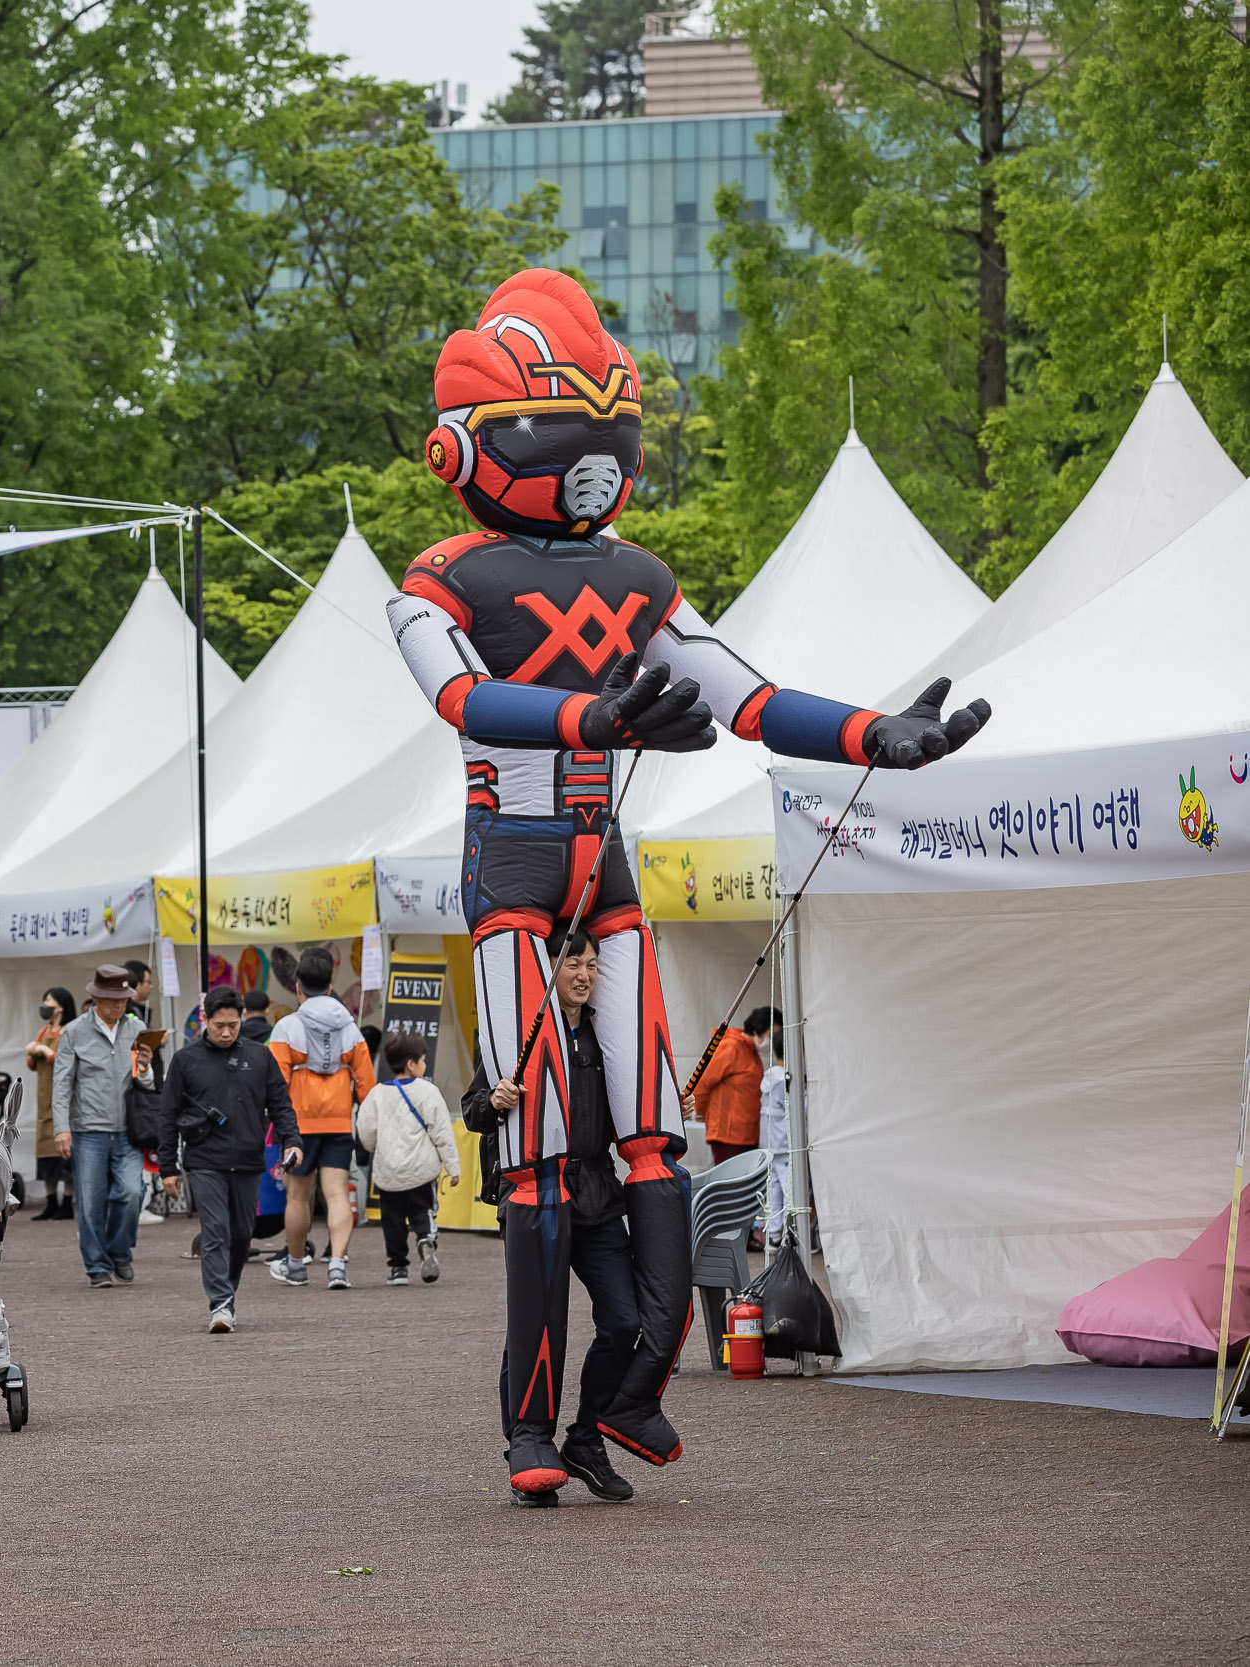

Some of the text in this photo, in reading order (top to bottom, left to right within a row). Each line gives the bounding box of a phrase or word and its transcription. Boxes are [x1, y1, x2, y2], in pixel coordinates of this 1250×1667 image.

[793, 794, 822, 811] 광진구
[900, 787, 1141, 860] 해피할머니 옛이야기 여행
[712, 871, 756, 902] 업싸이클
[393, 979, 442, 999] EVENT
